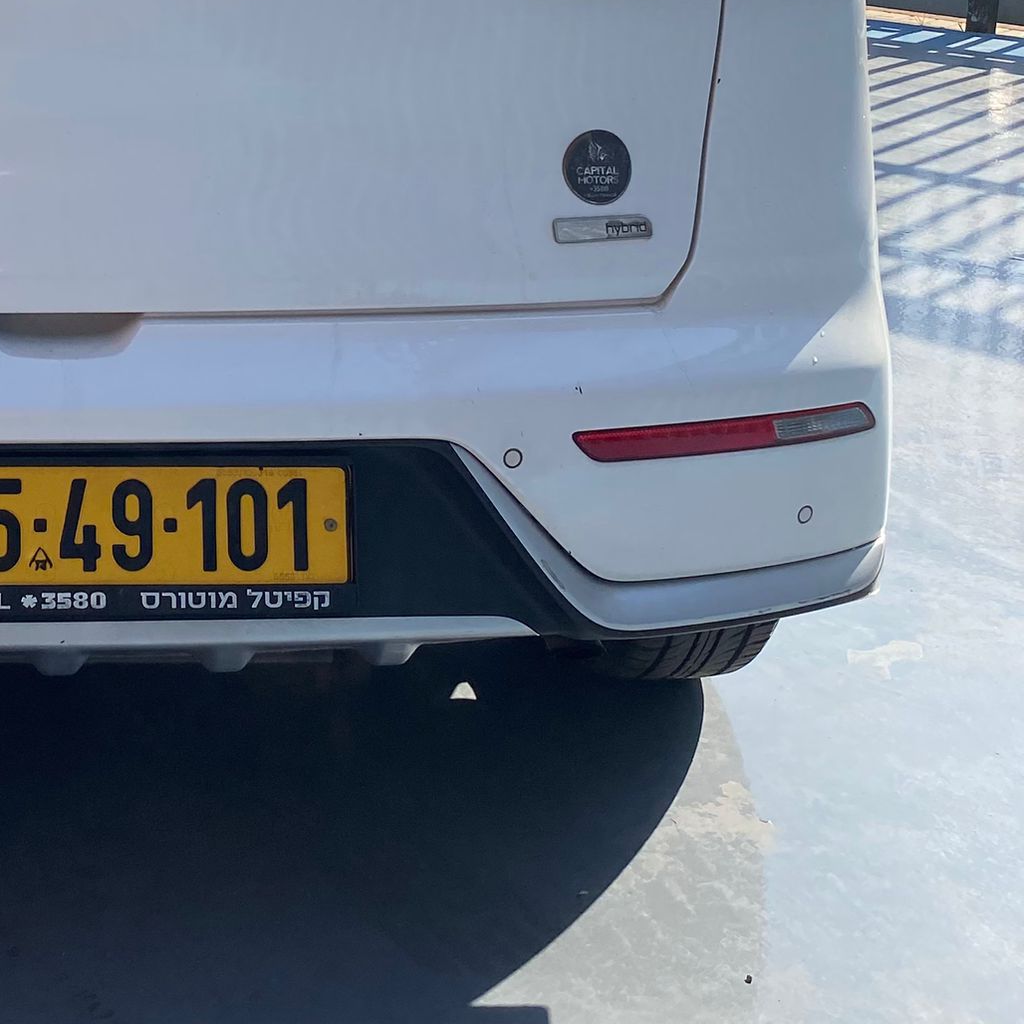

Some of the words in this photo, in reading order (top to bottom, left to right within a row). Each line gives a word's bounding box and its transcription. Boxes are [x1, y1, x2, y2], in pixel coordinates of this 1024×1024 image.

[576, 166, 620, 176] CAPITAL
[140, 591, 238, 610] מוטורס
[246, 589, 331, 611] קפיטל
